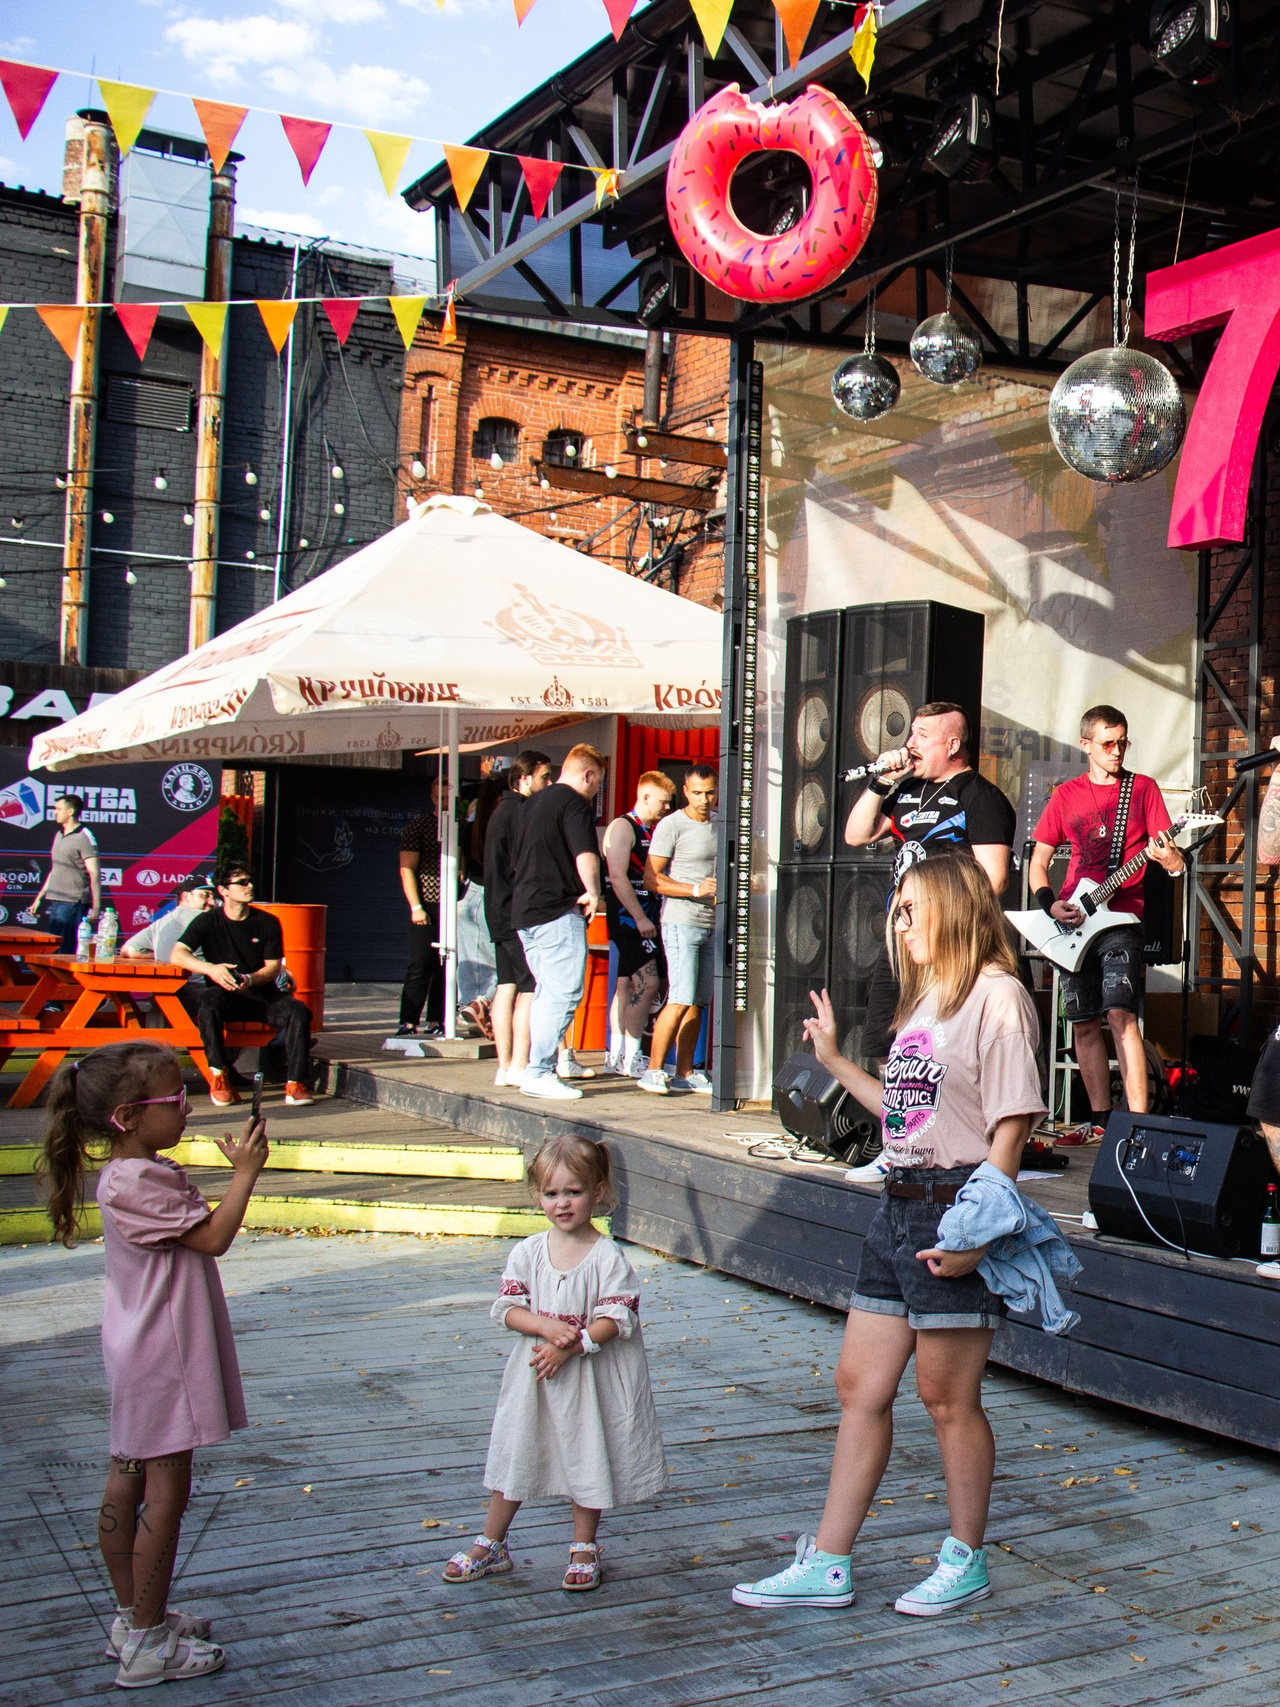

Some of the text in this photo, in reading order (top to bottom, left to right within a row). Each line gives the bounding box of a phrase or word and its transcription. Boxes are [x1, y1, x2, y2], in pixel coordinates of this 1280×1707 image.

[580, 696, 609, 707] 1581
[906, 1111, 926, 1131] PARTS
[910, 1145, 935, 1156] Town
